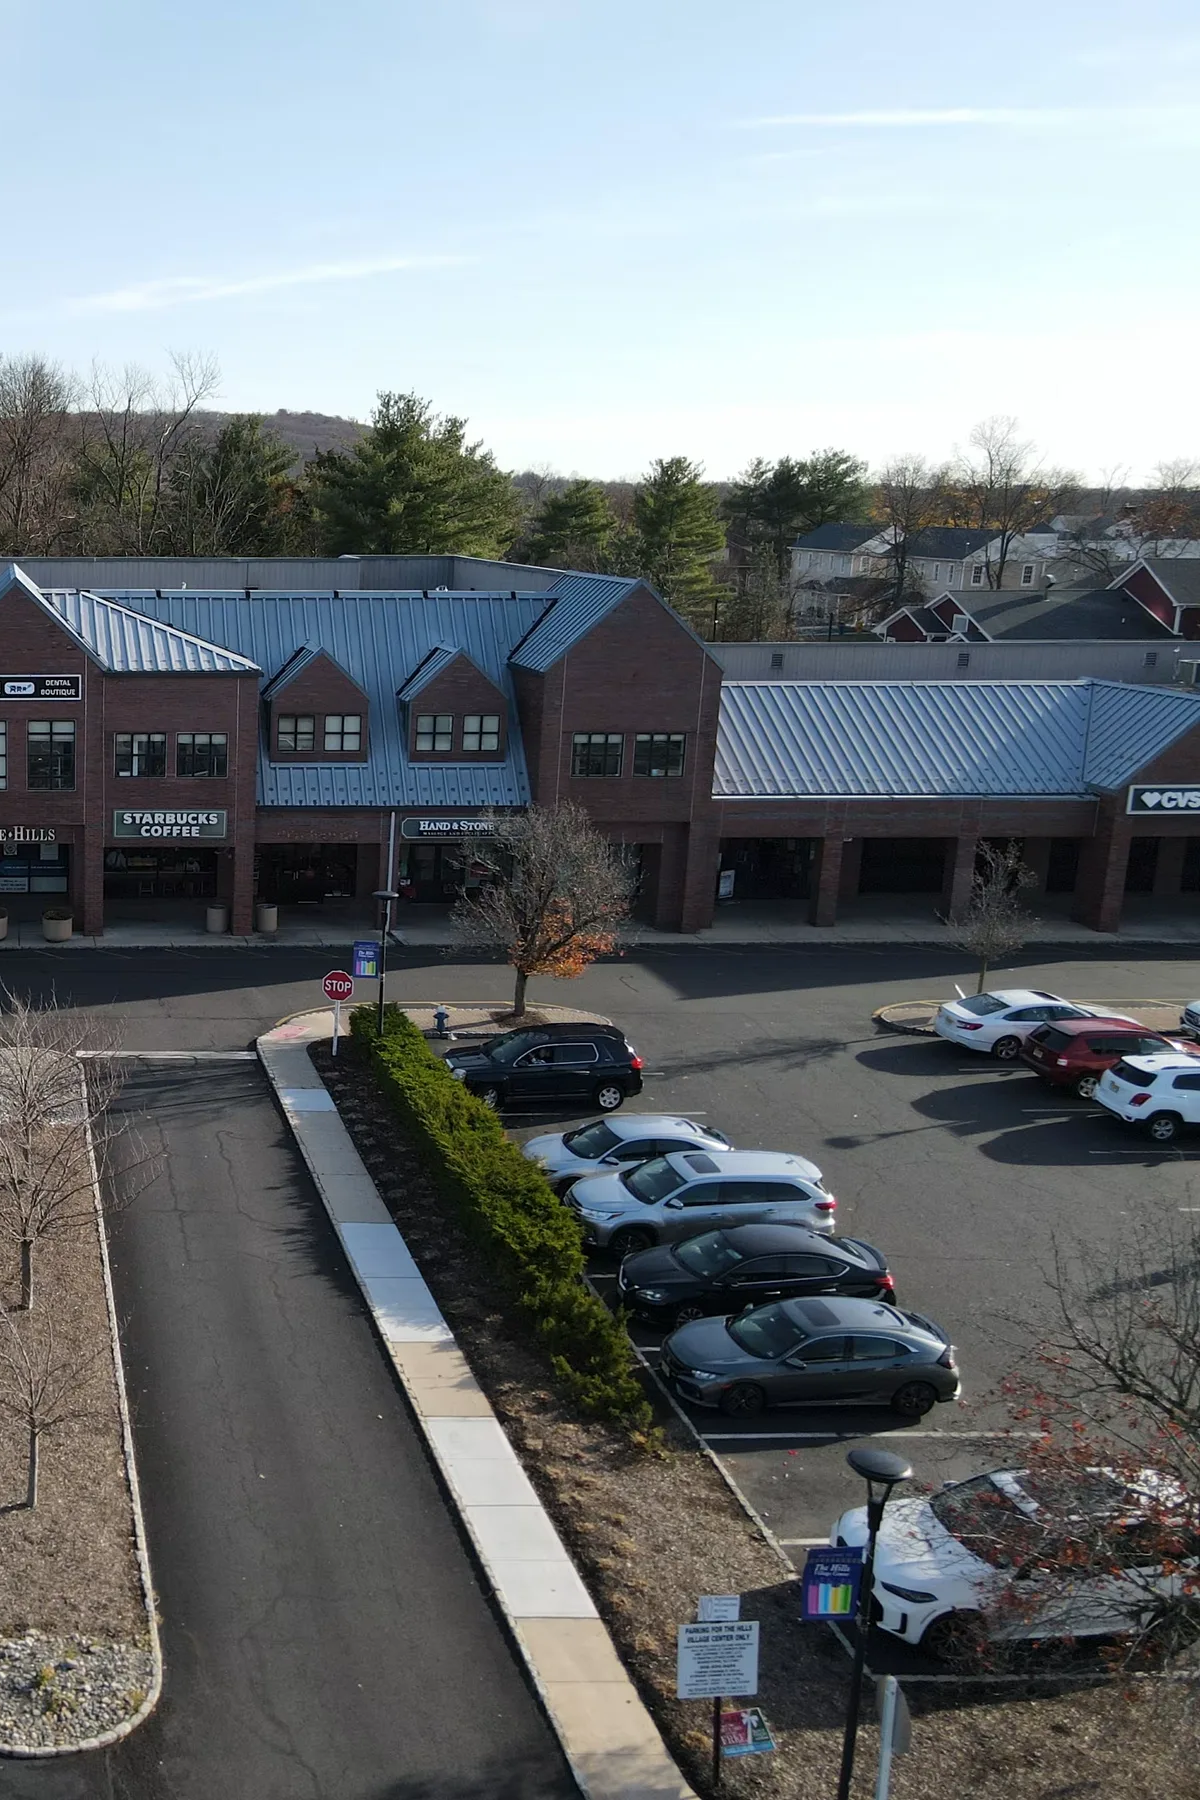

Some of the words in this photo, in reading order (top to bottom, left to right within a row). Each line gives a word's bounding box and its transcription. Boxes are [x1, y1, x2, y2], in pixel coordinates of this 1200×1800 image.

[1161, 791, 1200, 808] CVS
[123, 813, 218, 824] STARBUCKS
[420, 821, 451, 830] HAND
[452, 821, 459, 830] &
[460, 820, 495, 831] STONE
[13, 825, 56, 841] HILLS
[140, 826, 200, 837] COFFEE
[325, 980, 351, 992] STOP
[685, 1626, 710, 1634] PARKING
[737, 1624, 752, 1632] HILLS
[687, 1635, 710, 1643] VILLAGE
[711, 1634, 734, 1642] CENTER
